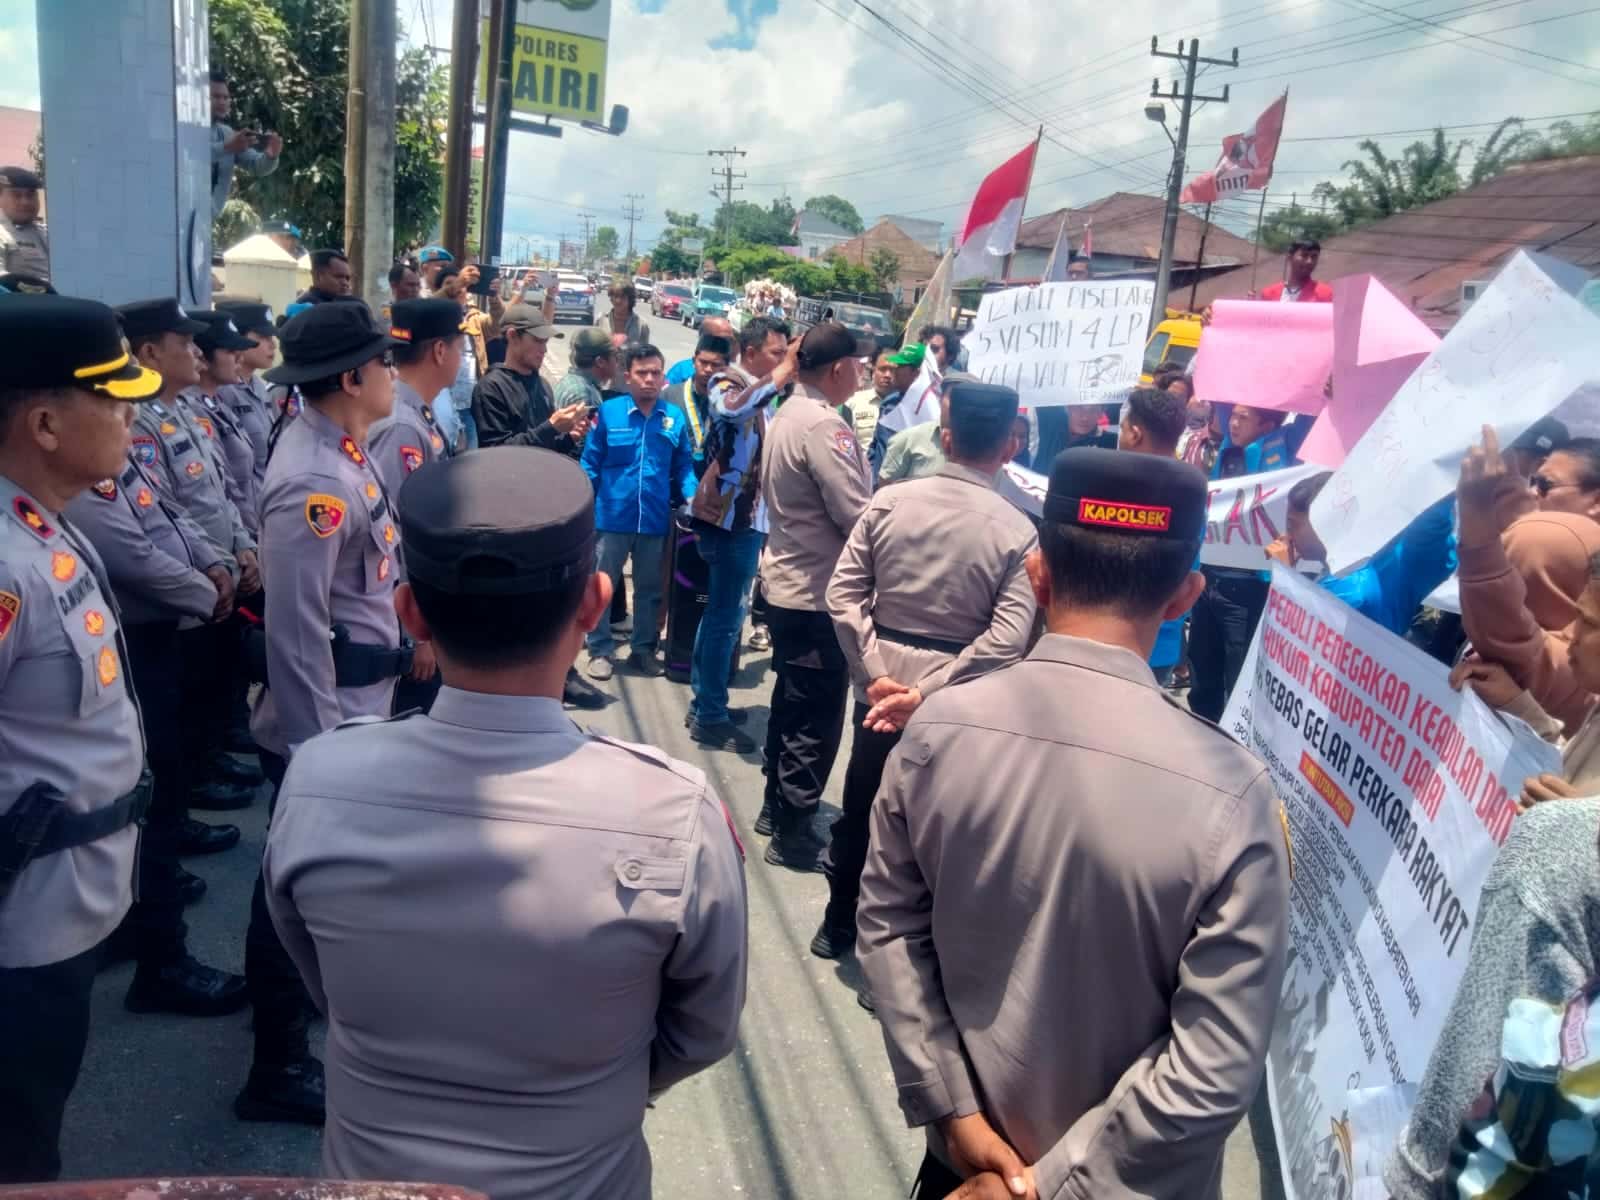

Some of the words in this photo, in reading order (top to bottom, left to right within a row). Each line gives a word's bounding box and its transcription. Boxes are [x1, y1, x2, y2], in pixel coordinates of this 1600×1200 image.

[513, 33, 578, 62] POLRES
[513, 60, 599, 112] AIRI
[1000, 319, 1073, 355] VISUM
[1081, 317, 1102, 350] 4
[1108, 311, 1143, 348] LP
[1084, 503, 1166, 526] KAPOLSEK
[1263, 623, 1311, 687] HUKUM
[1308, 663, 1406, 774] KABUPATEN
[1402, 746, 1446, 823] DAIRI
[1268, 586, 1315, 645] PEDULI
[1312, 621, 1411, 721] PENEGAKAN
[1408, 693, 1484, 803] KEADILAN
[1475, 771, 1518, 849] DAN
[1303, 708, 1352, 779] GELAR
[1349, 752, 1418, 864] PERKARA
[1408, 836, 1470, 959] RAKYAT
